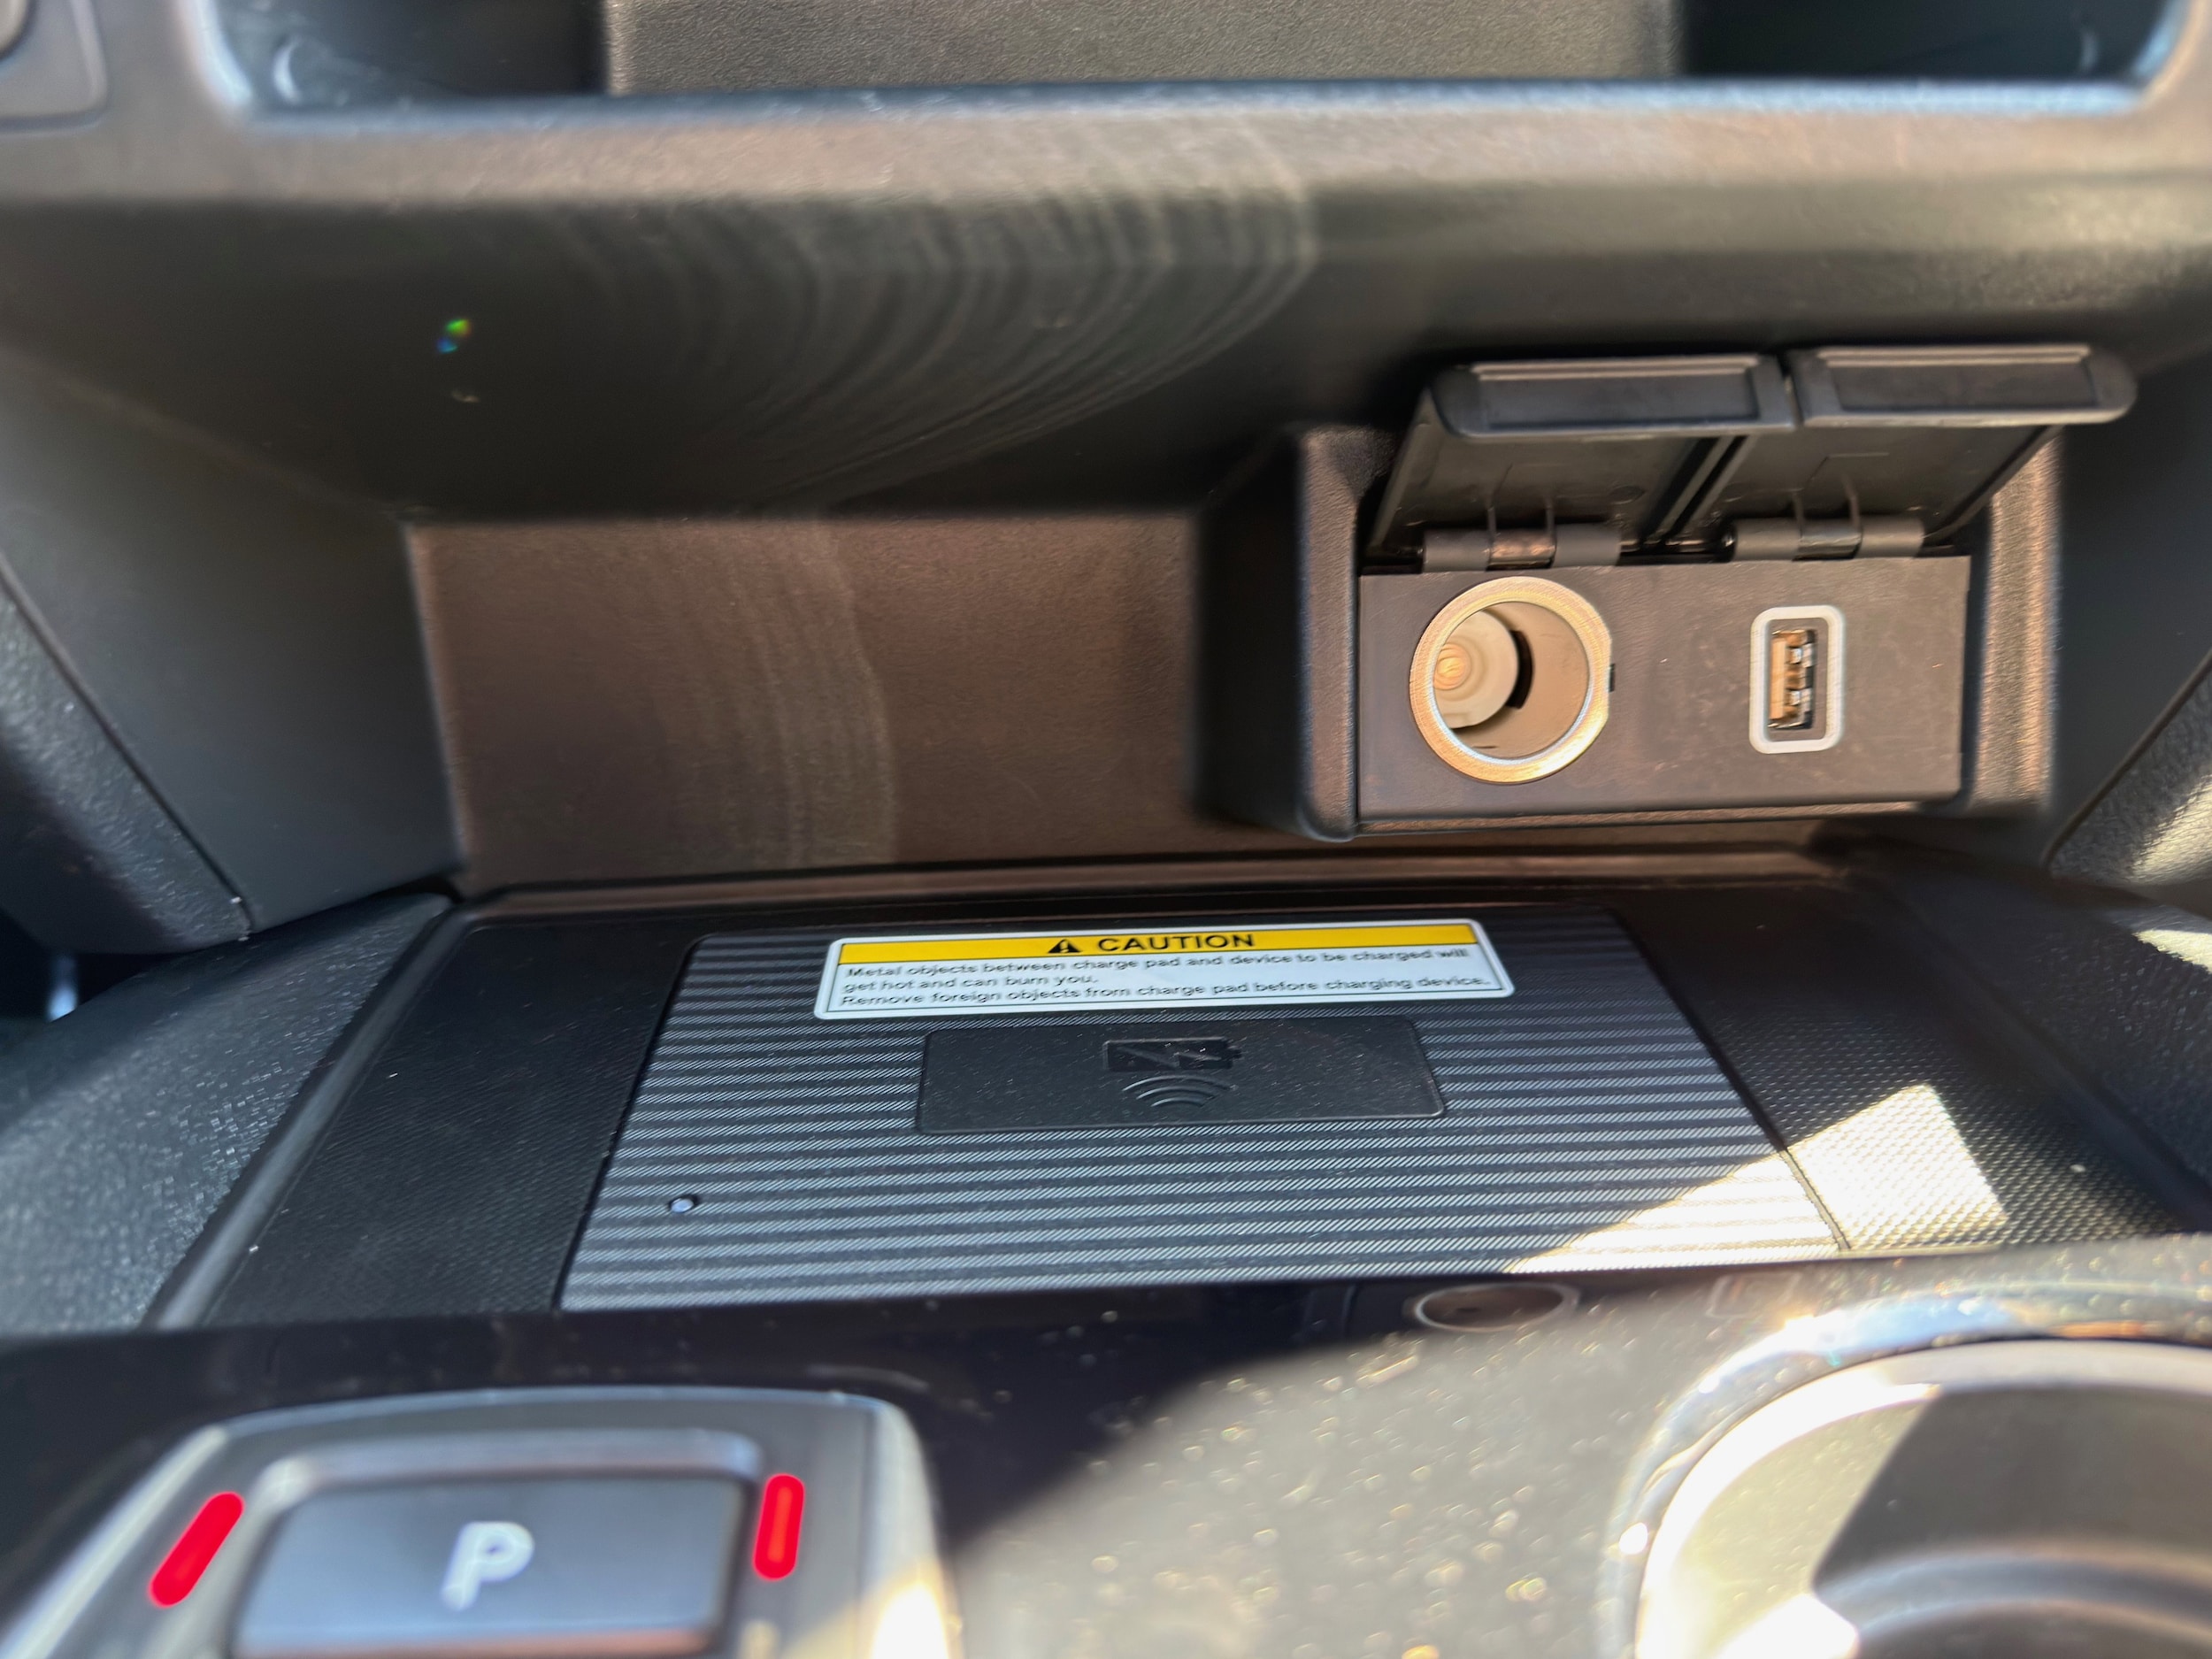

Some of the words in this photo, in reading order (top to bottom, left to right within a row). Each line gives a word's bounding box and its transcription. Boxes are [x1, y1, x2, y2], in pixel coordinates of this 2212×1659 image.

[1098, 933, 1255, 951] CAUTION
[847, 965, 902, 977] Metal
[907, 964, 978, 977] objects
[983, 960, 1065, 972] between
[1073, 959, 1139, 971] charge
[1145, 956, 1180, 970] pad
[1187, 956, 1224, 966] and
[1230, 954, 1293, 965] device
[1296, 953, 1317, 963] to
[1324, 952, 1346, 962] be
[1352, 949, 1432, 962] charged
[1436, 949, 1469, 958] will
[841, 995, 924, 1007] Remove
[932, 991, 1001, 1003] foreign
[1007, 988, 1081, 1002] objects
[1085, 987, 1132, 998] from
[1137, 985, 1205, 996] charge
[1211, 982, 1249, 995] pad
[1254, 980, 1318, 993] before
[1325, 978, 1413, 991] charging
[1417, 975, 1492, 987] device.
[843, 980, 877, 994] get
[880, 979, 917, 990] hot
[920, 978, 956, 988] and
[962, 978, 997, 987] can
[1005, 975, 1049, 986] burn
[1055, 974, 1099, 987] you.
[441, 1521, 535, 1612] P
